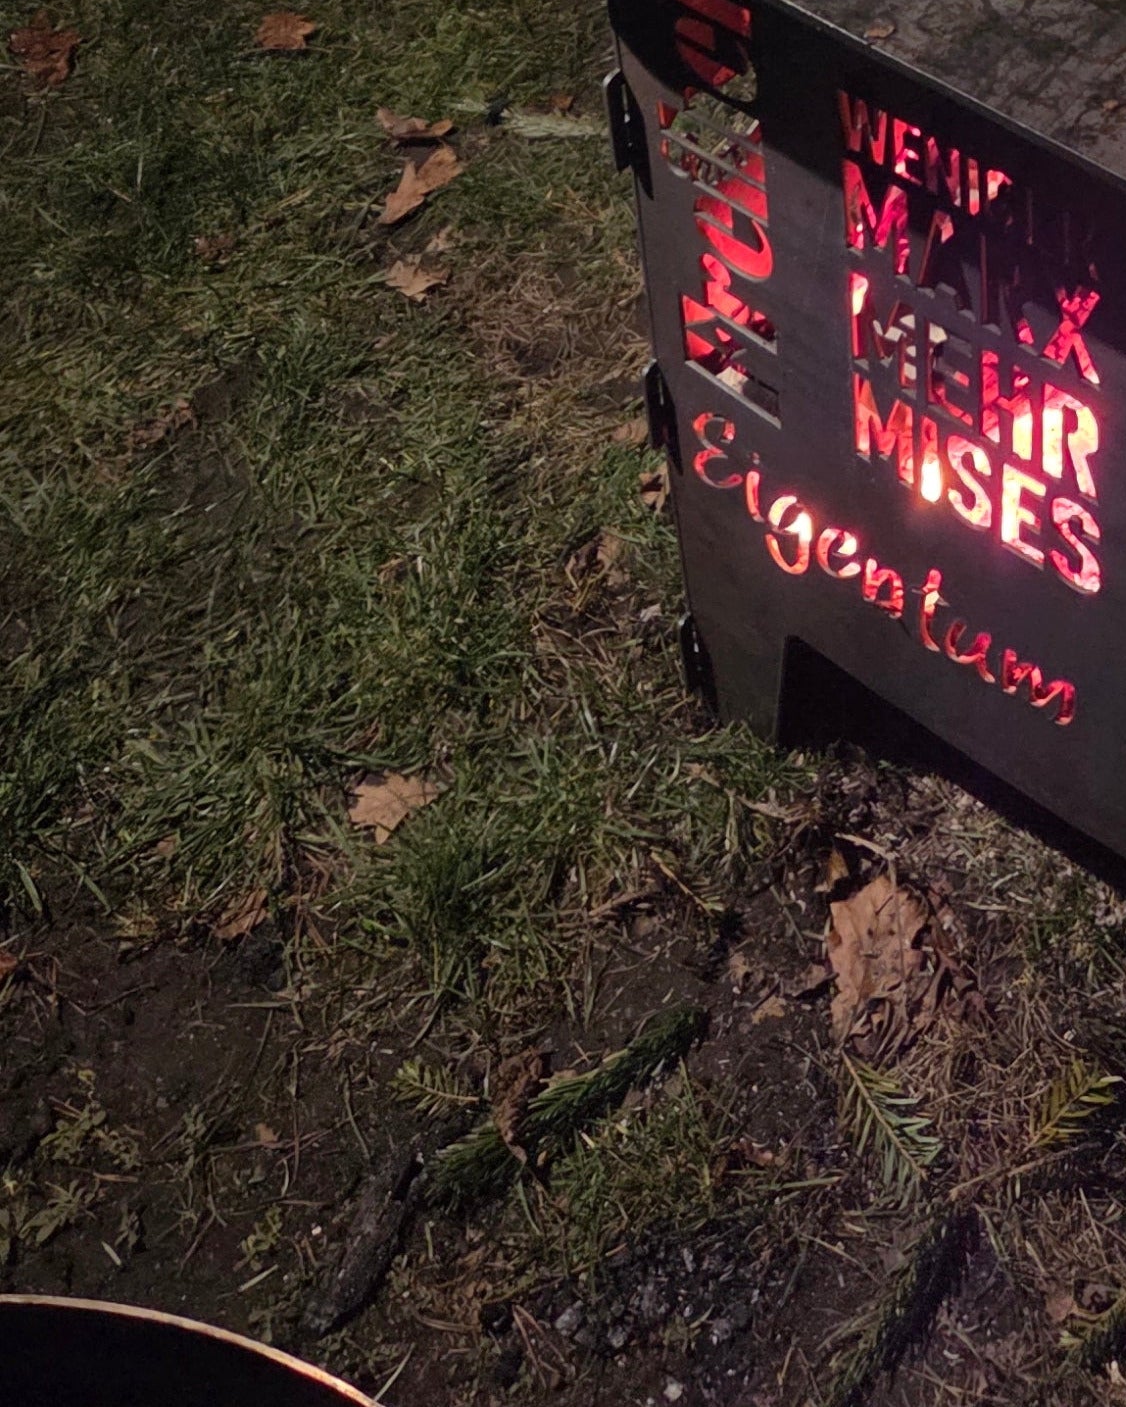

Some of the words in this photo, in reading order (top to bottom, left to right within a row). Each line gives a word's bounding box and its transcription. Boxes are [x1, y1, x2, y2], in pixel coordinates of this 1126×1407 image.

[848, 271, 1101, 501] MEHR
[853, 372, 1103, 594] MISES
[692, 410, 1078, 727] Eigentum
